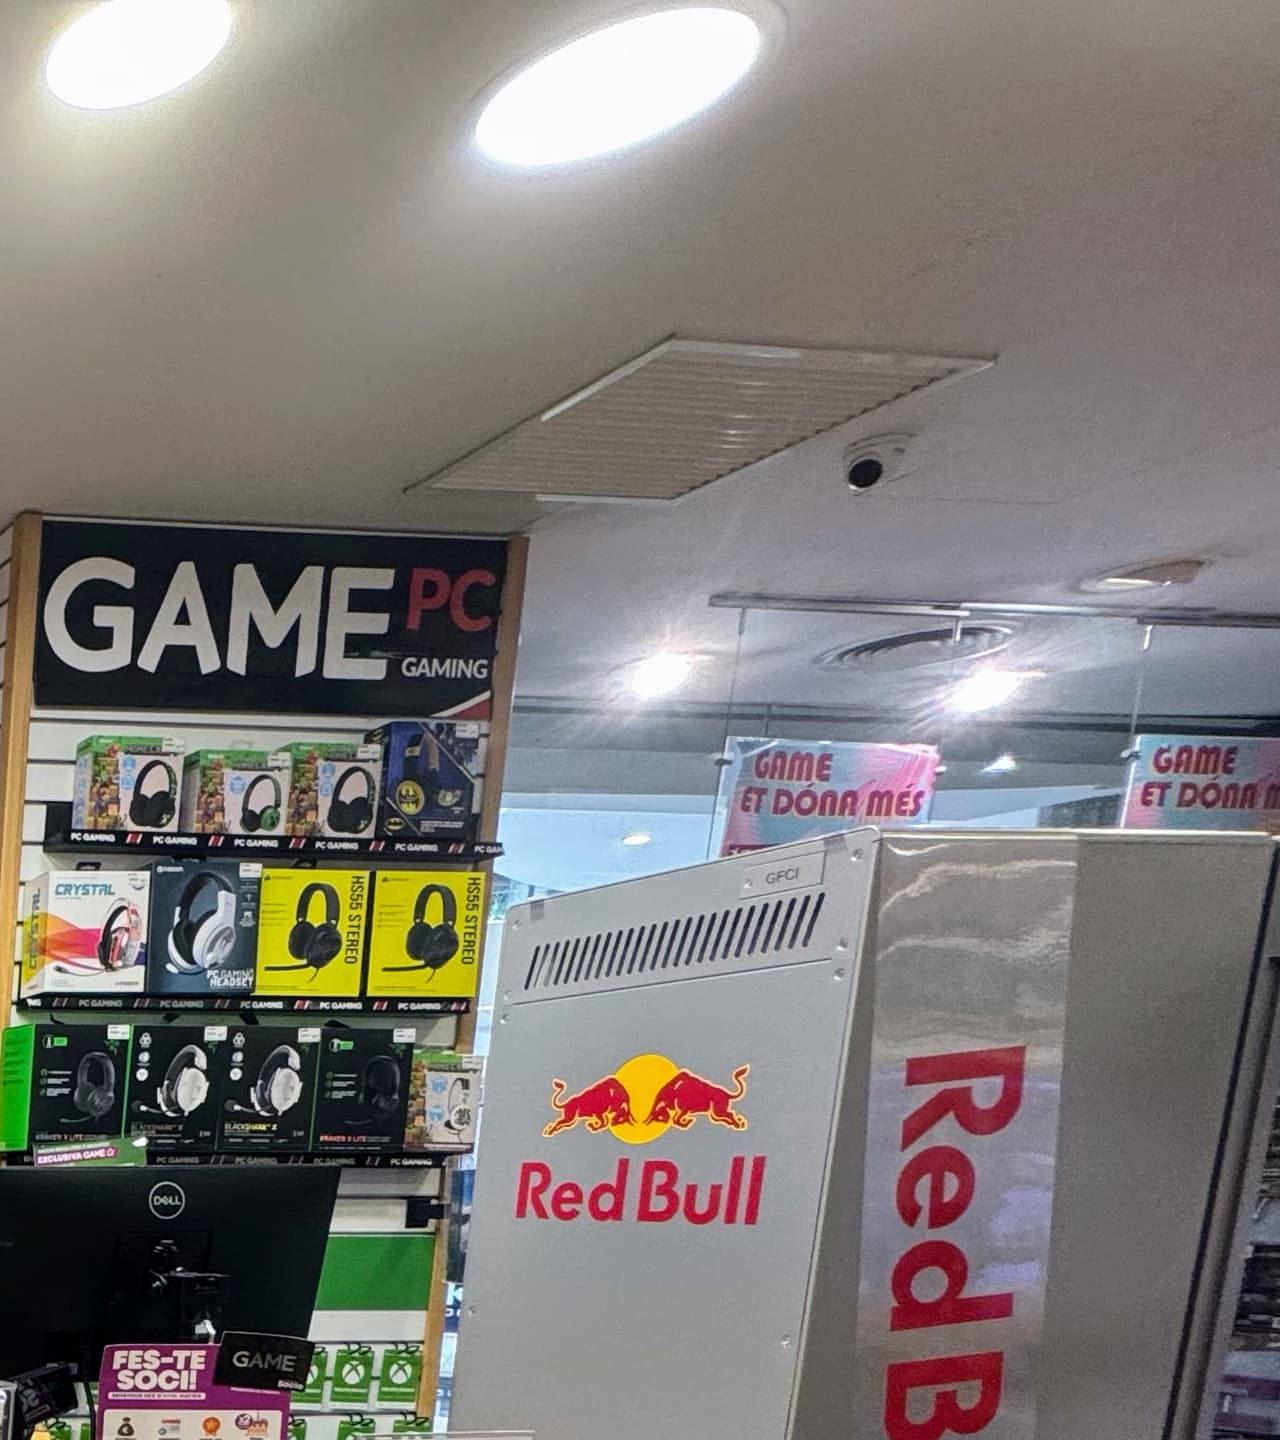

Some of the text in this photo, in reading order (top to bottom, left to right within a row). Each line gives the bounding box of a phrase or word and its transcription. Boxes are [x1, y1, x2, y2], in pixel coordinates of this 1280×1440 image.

[44, 557, 498, 681] GAME PC
[402, 657, 489, 680] GAMING
[754, 749, 834, 782] GAME
[1153, 745, 1239, 774] GAME
[741, 779, 925, 818] ET DÓNA MÉS
[1141, 781, 1168, 809] ET
[54, 883, 116, 896] CRYSTAL
[765, 867, 799, 885] GFCI
[344, 875, 365, 965] HS55 STEREO
[461, 877, 481, 965] HS55 STEREO
[37, 1148, 106, 1164] EXCLUSIVA GAME
[153, 1194, 181, 1206] DELL
[515, 1155, 766, 1225] Red Bull
[890, 1045, 1027, 1331] Red
[112, 1349, 206, 1370] FES-TE
[232, 1350, 297, 1373] GAME
[116, 1369, 197, 1391] SOCI!
